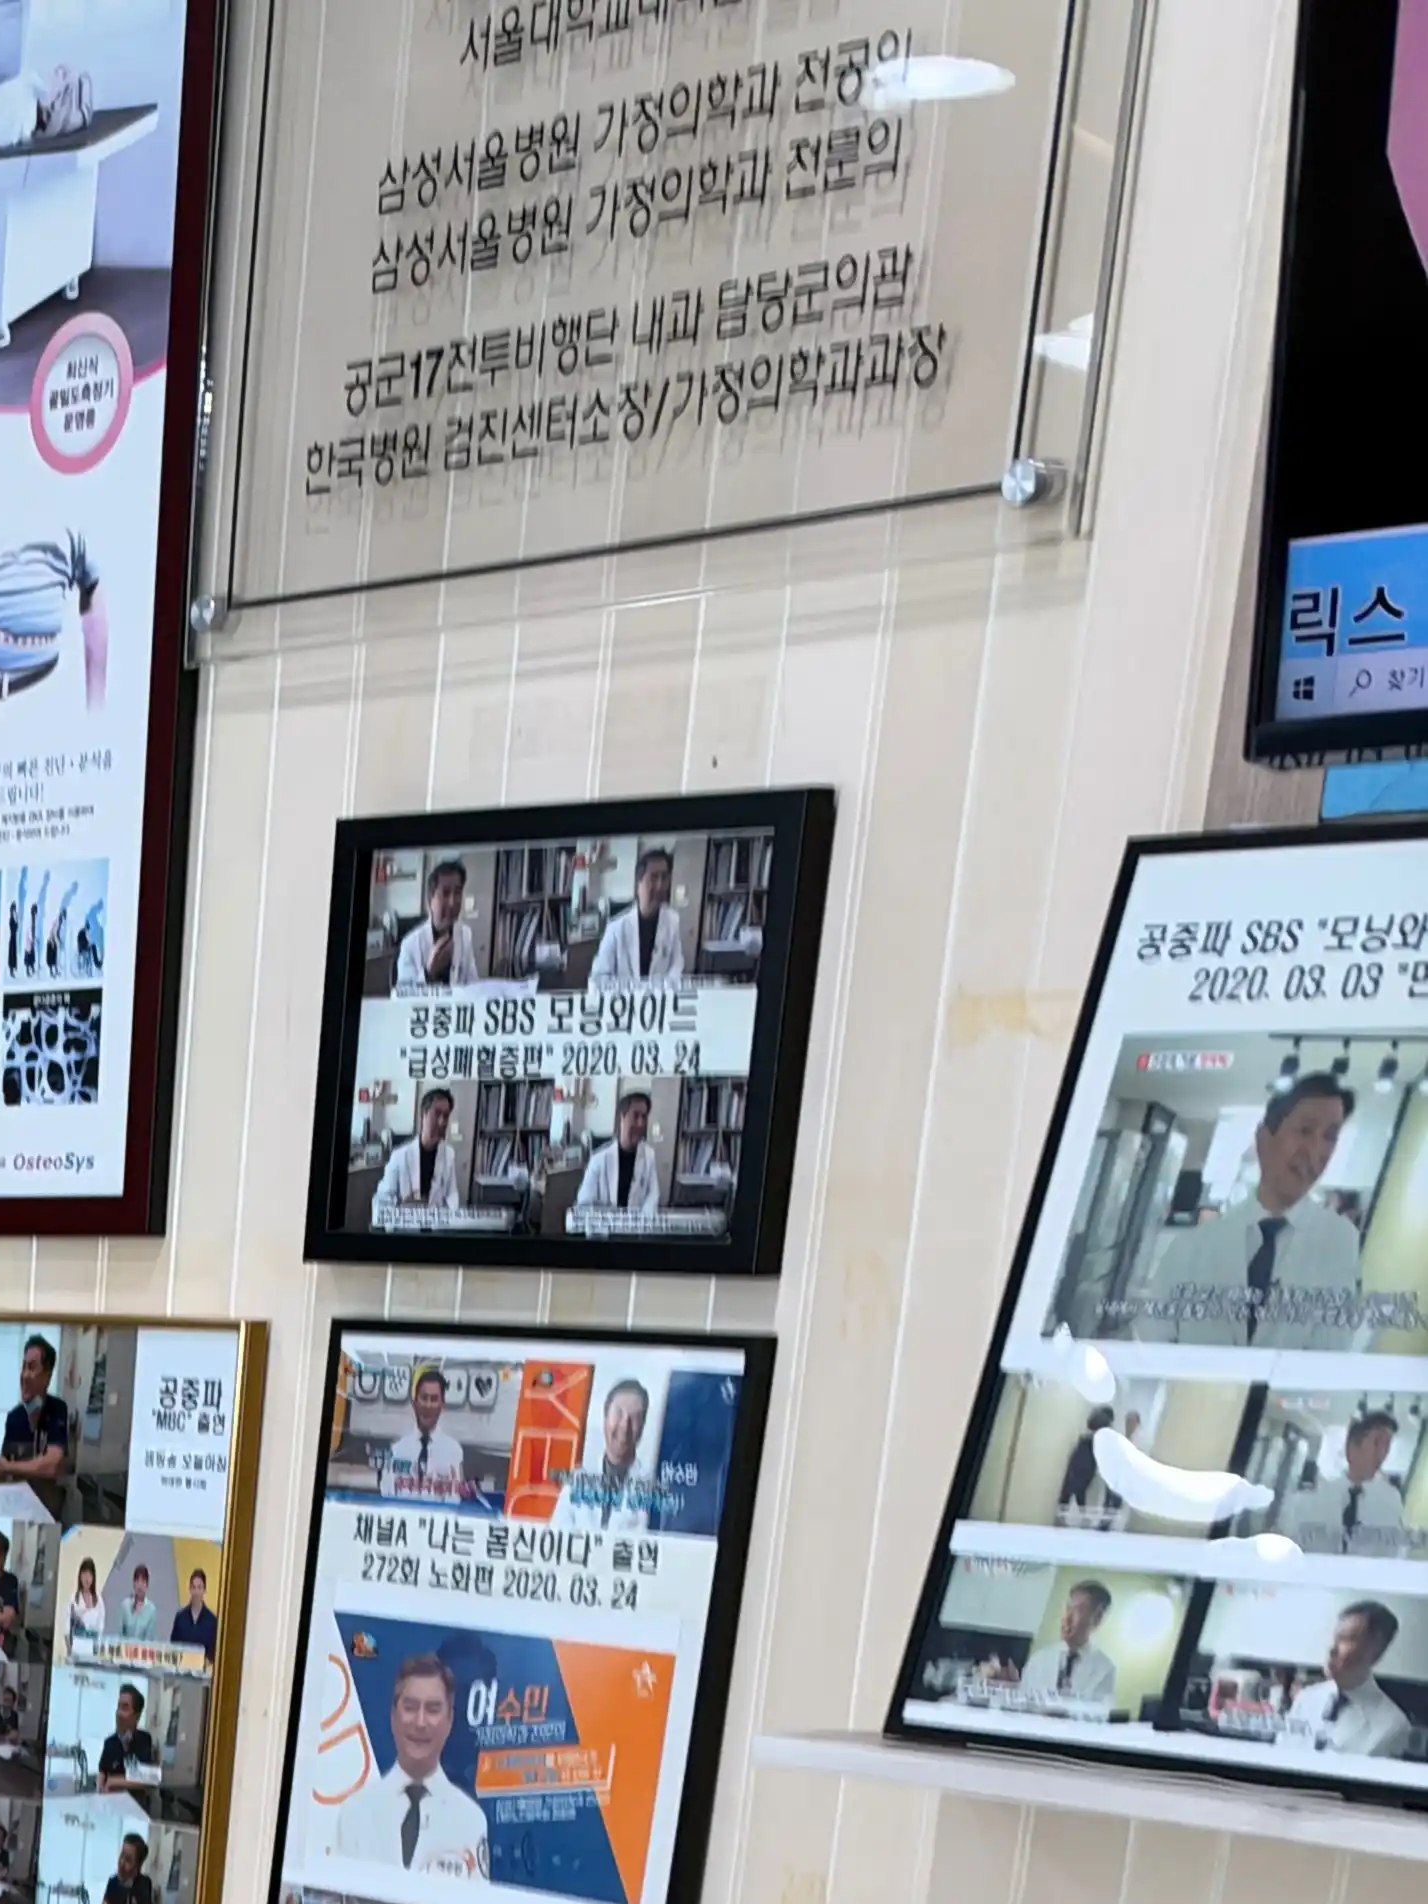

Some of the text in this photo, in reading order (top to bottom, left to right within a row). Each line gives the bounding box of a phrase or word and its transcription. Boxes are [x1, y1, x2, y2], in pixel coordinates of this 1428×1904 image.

[379, 110, 580, 215] 삼성서울병원
[594, 60, 781, 158] 가정의학과
[373, 117, 902, 294] 삼성서울병원 가정의학과 전문의
[344, 242, 913, 417] 공군17전투비행단 내과 담당군의관
[306, 322, 947, 496] 한국병원 검진센터소장/가정의학과과장
[1290, 586, 1405, 657] 릭스
[1137, 920, 1232, 960] 공중파
[1241, 918, 1304, 956] SBS
[1189, 966, 1269, 1003] 2020.
[1284, 964, 1326, 1001] 03.
[410, 992, 698, 1038] 공중파 SBS 모닝와이드
[561, 1041, 621, 1076] 2020.
[631, 1040, 663, 1075] 03.
[675, 1040, 702, 1076] 24
[13, 1152, 95, 1174] OsteoSys
[160, 1376, 222, 1411] 공중파
[353, 1512, 407, 1548] 채널A
[613, 1539, 659, 1575] 출연
[362, 1552, 420, 1587] 272회
[429, 1559, 494, 1595] 노화편
[503, 1564, 561, 1602] 2020.
[611, 1577, 638, 1610] 24
